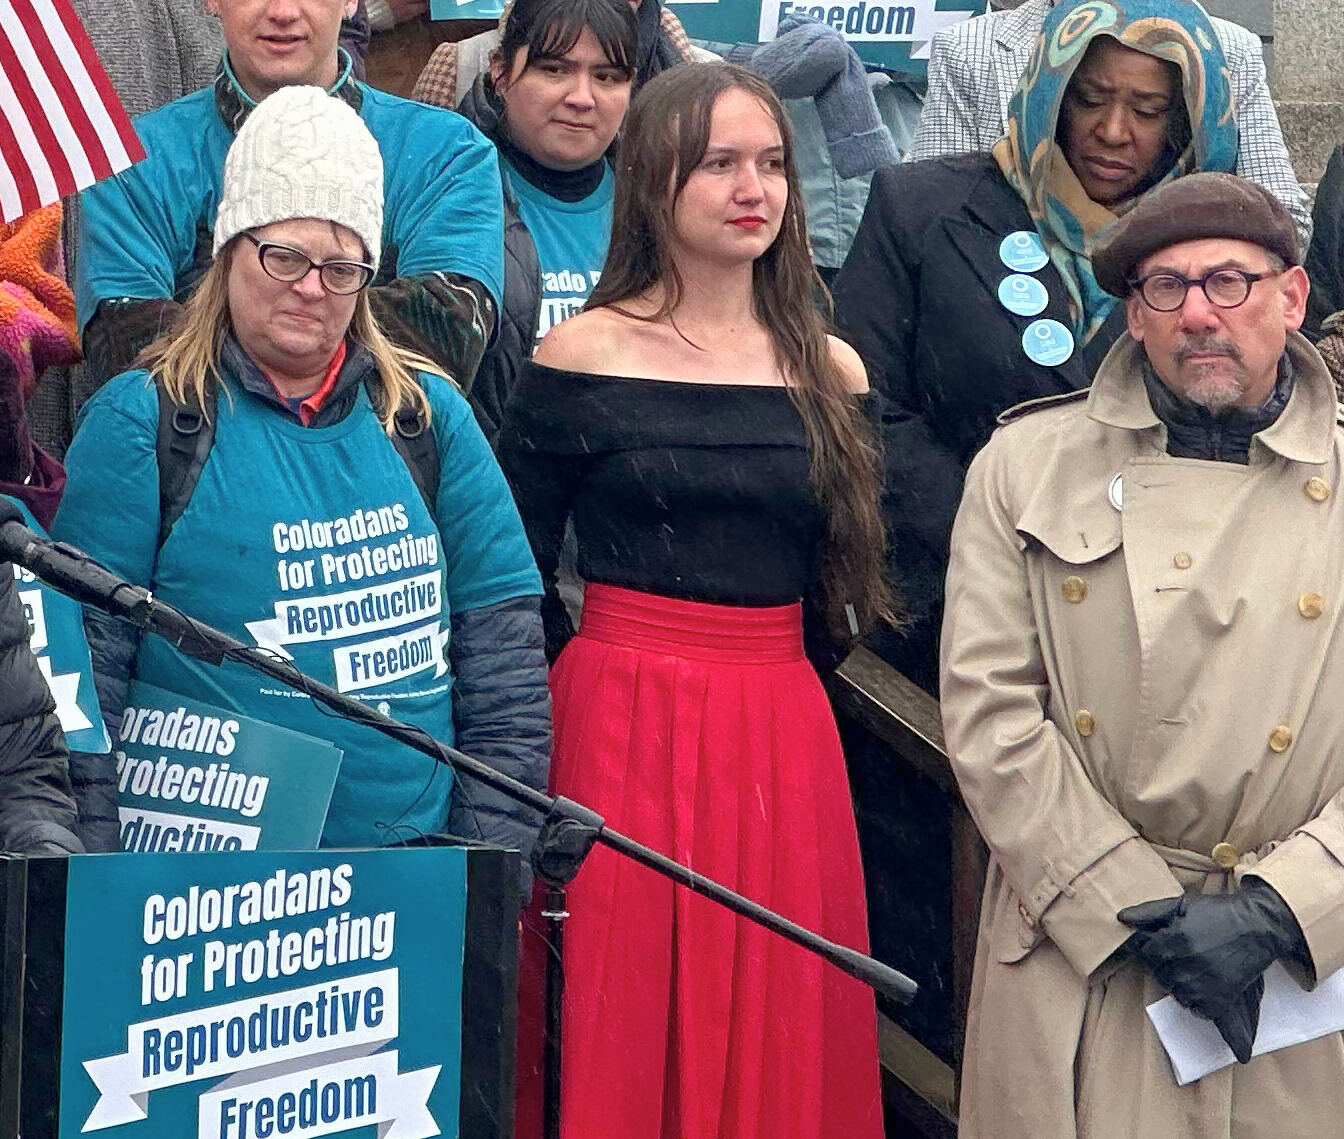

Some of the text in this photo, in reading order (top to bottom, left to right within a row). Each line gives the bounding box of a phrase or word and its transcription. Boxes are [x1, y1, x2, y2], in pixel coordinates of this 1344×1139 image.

[272, 503, 409, 554] Coloradans
[277, 534, 439, 592] for Protecting
[286, 581, 437, 636] Reproductive
[349, 635, 433, 683] Freedom
[142, 863, 354, 945] Coloradans
[140, 910, 397, 1006] for Protecting
[142, 985, 385, 1078] Reproductive
[219, 1073, 378, 1139] Freedom
